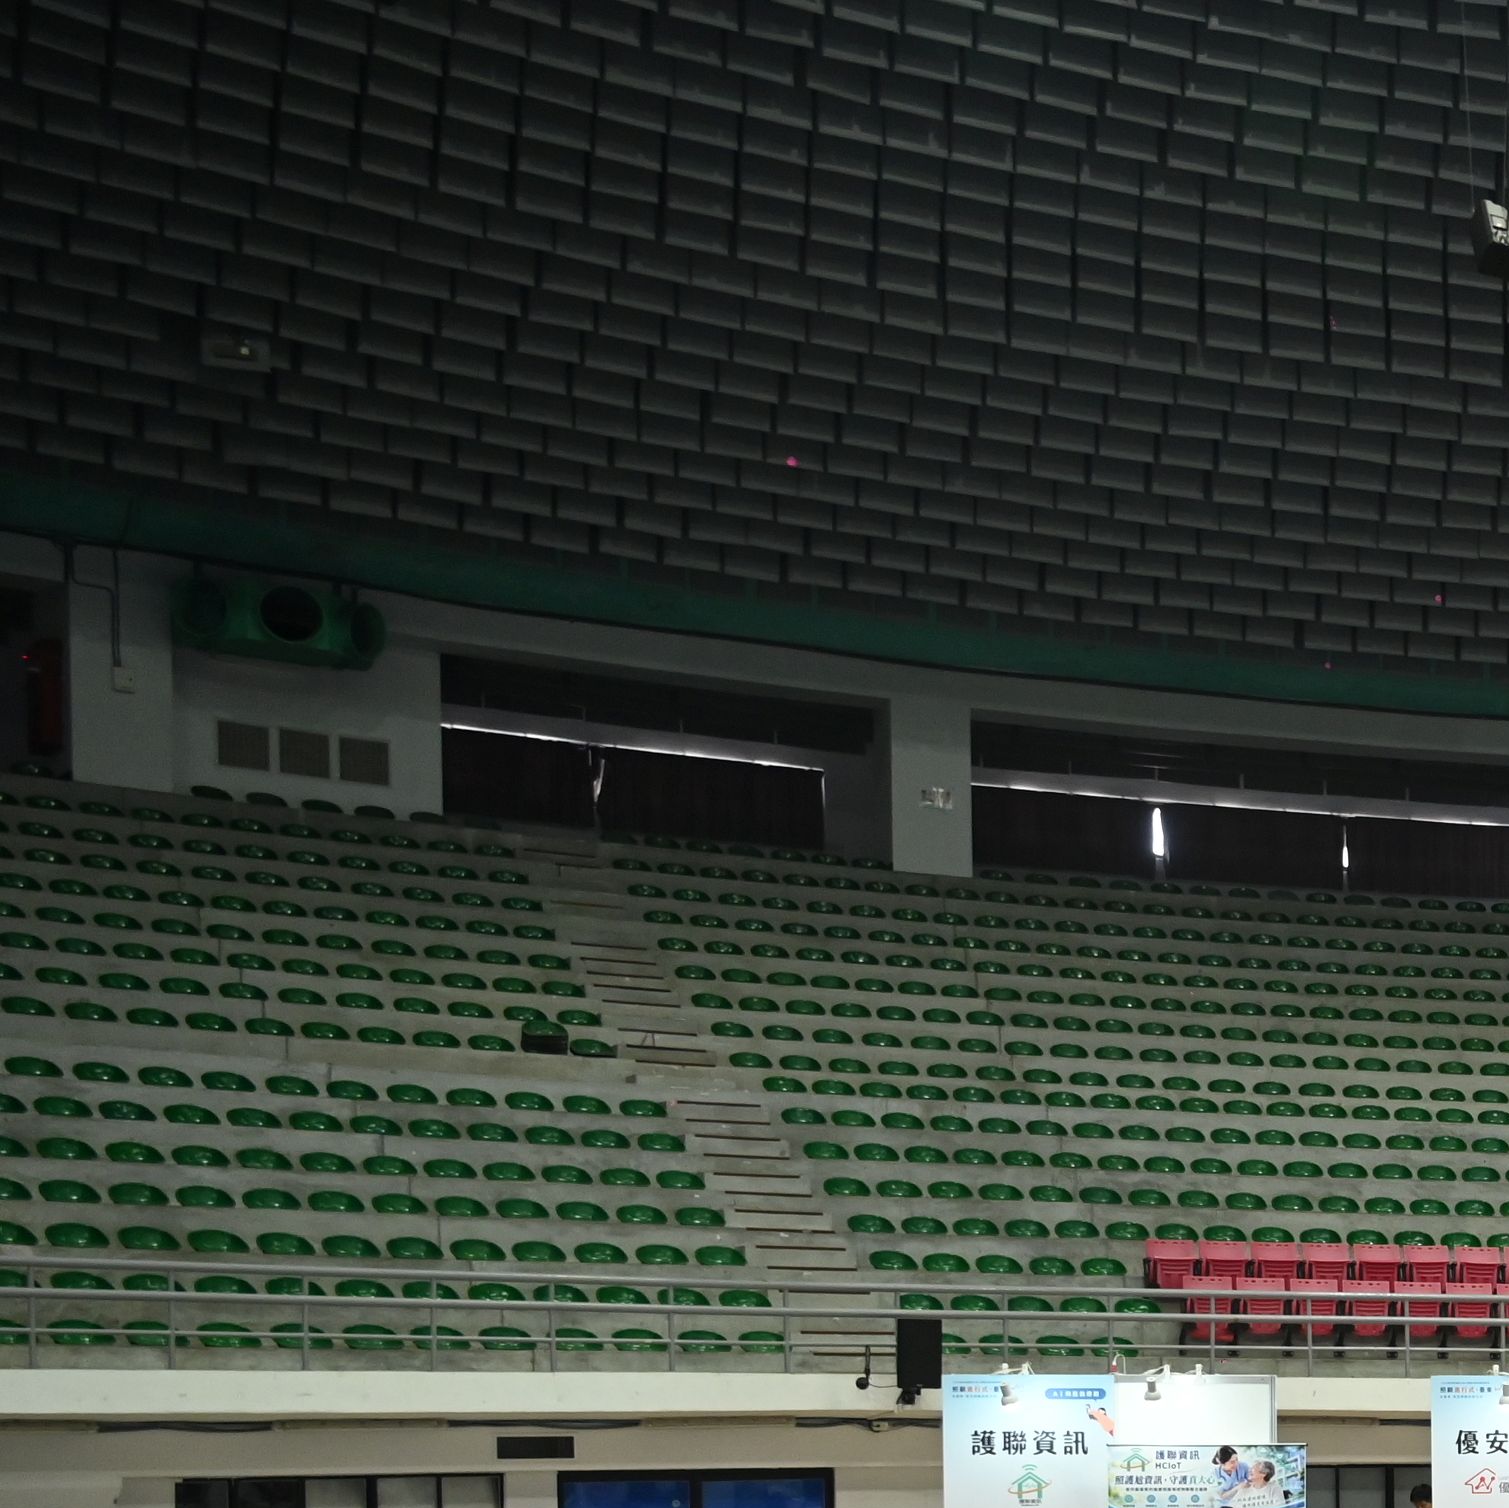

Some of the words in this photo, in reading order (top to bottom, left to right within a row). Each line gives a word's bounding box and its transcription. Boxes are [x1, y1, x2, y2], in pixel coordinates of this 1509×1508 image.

[971, 1430, 1089, 1456] 護聯資訊
[1155, 1450, 1200, 1460] 護聯資訊
